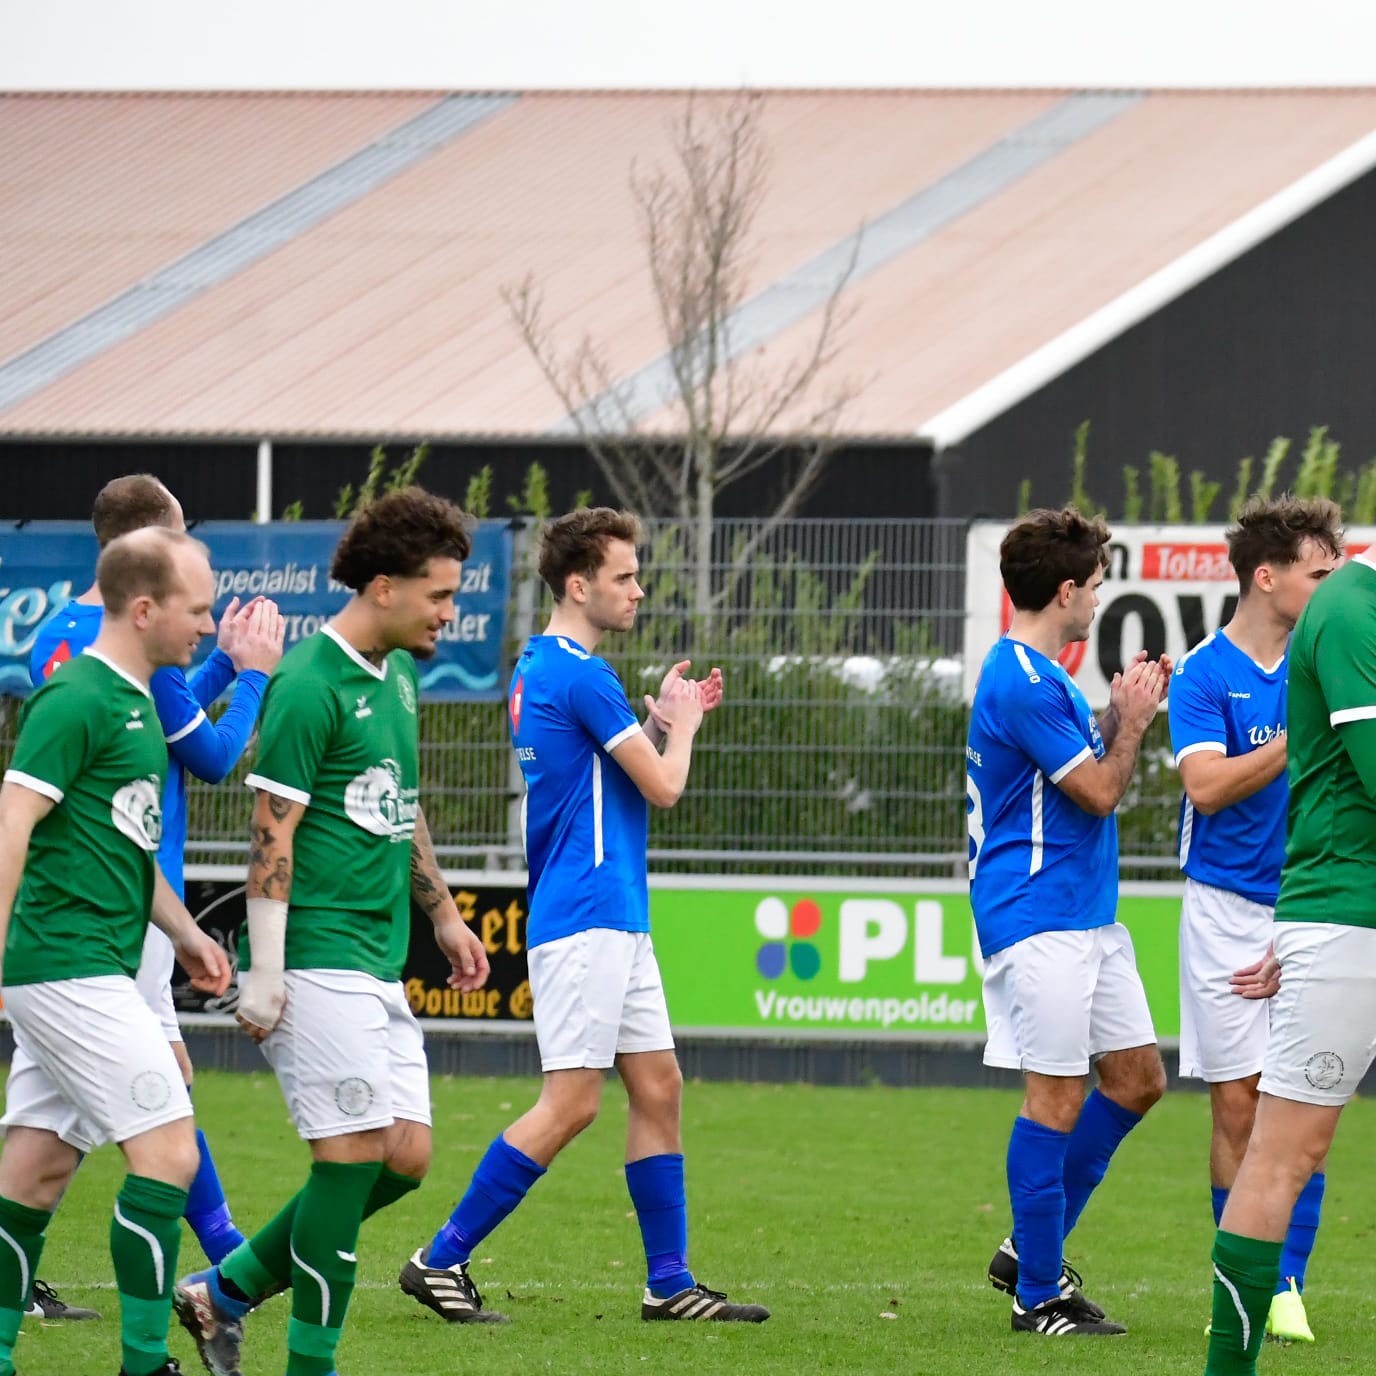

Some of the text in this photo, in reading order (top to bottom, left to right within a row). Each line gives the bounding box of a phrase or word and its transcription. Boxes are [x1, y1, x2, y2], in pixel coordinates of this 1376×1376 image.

[461, 562, 492, 593] zit
[838, 898, 984, 984] PL
[755, 989, 978, 1028] Vrouwenpolder
